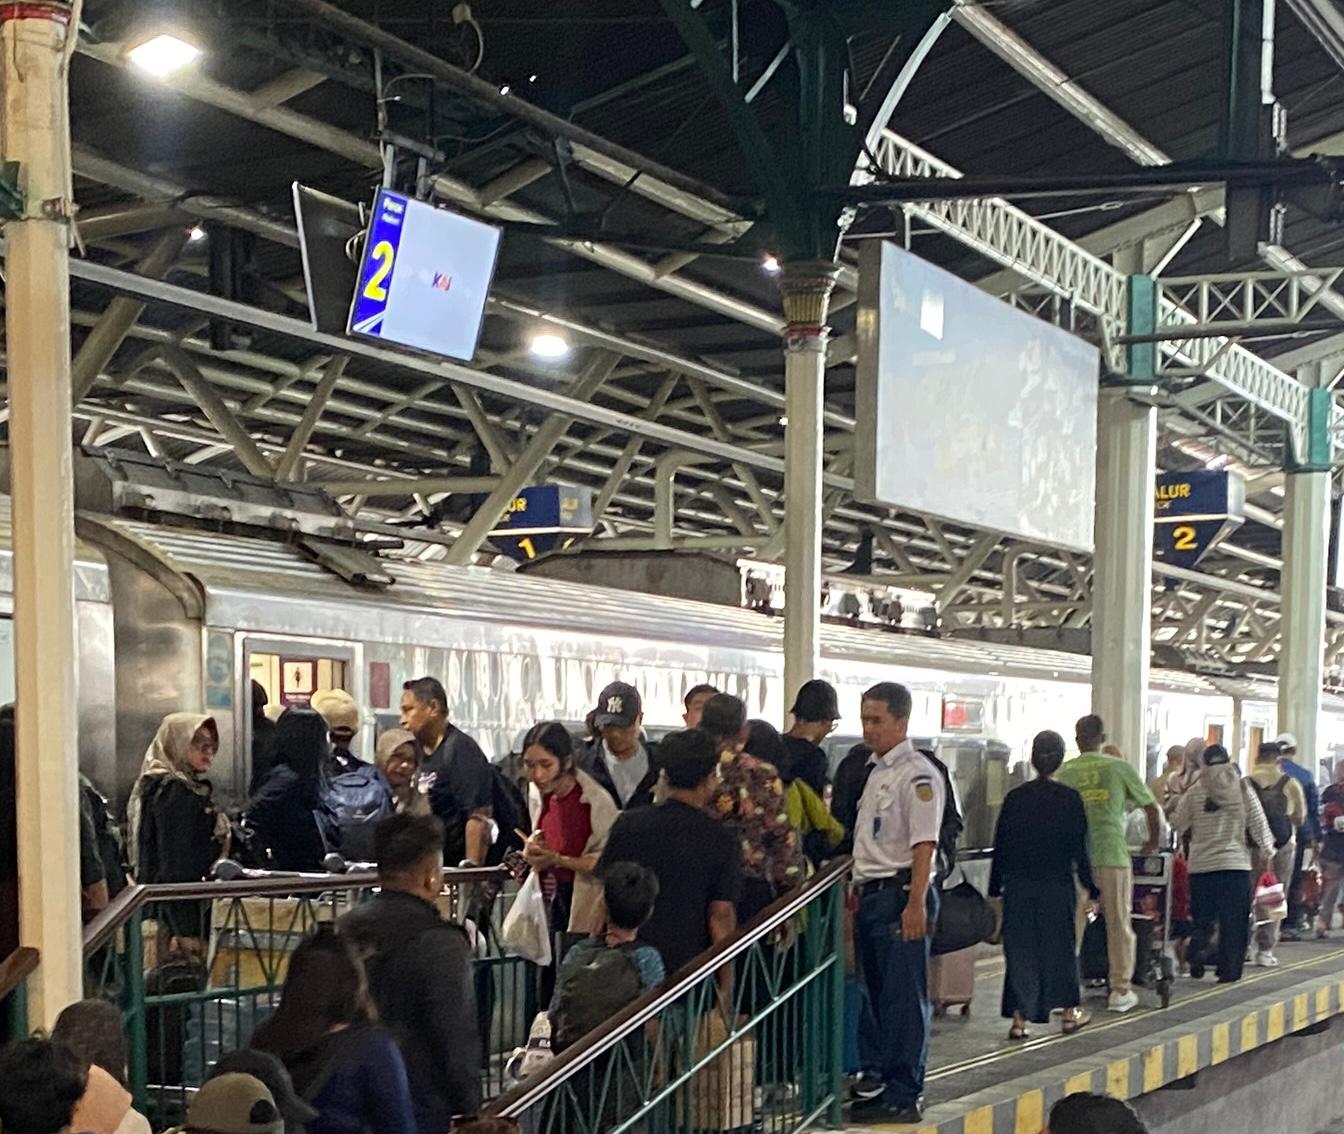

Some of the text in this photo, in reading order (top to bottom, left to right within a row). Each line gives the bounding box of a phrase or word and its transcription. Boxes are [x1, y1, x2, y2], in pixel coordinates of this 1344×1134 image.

[363, 240, 394, 302] 2
[518, 537, 536, 559] 1
[1173, 526, 1198, 550] 2
